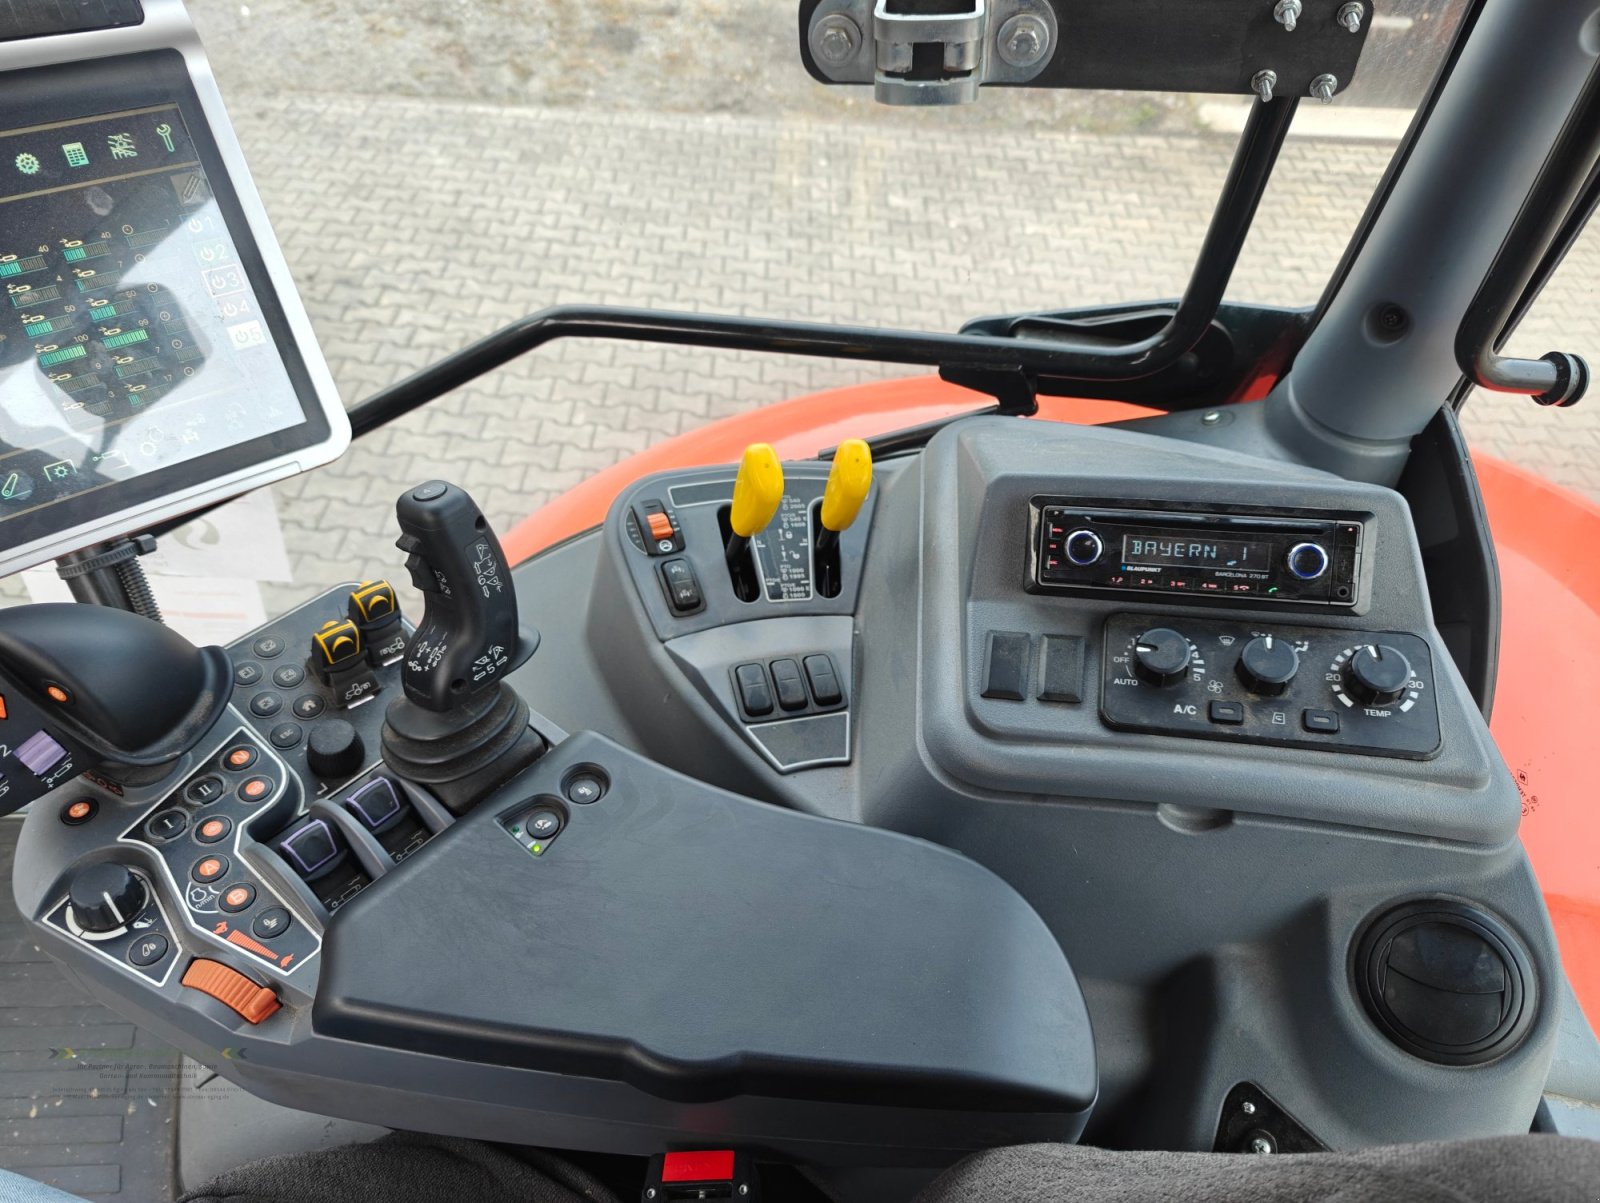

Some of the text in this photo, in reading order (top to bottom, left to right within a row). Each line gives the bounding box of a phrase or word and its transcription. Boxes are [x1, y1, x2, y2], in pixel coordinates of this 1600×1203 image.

[101, 231, 112, 240] 40
[38, 244, 50, 254] 40
[215, 243, 229, 260] 2
[227, 271, 240, 288] 3
[240, 300, 250, 314] 4
[138, 318, 150, 327] 99
[73, 333, 89, 343] 100
[248, 326, 262, 342] 5
[1131, 539, 1248, 561] BAYERN 1
[477, 574, 486, 585] 6
[1191, 650, 1200, 659] 4
[1113, 656, 1130, 664] OFF
[486, 663, 495, 674] 5
[1113, 677, 1139, 687] AUTO
[1193, 673, 1201, 682] 5
[1325, 672, 1341, 682] 20
[1407, 680, 1424, 689] 30
[1173, 703, 1198, 716] A/C
[1363, 708, 1392, 718] TEMP
[205, 863, 219, 876] A
[230, 890, 244, 904] B
